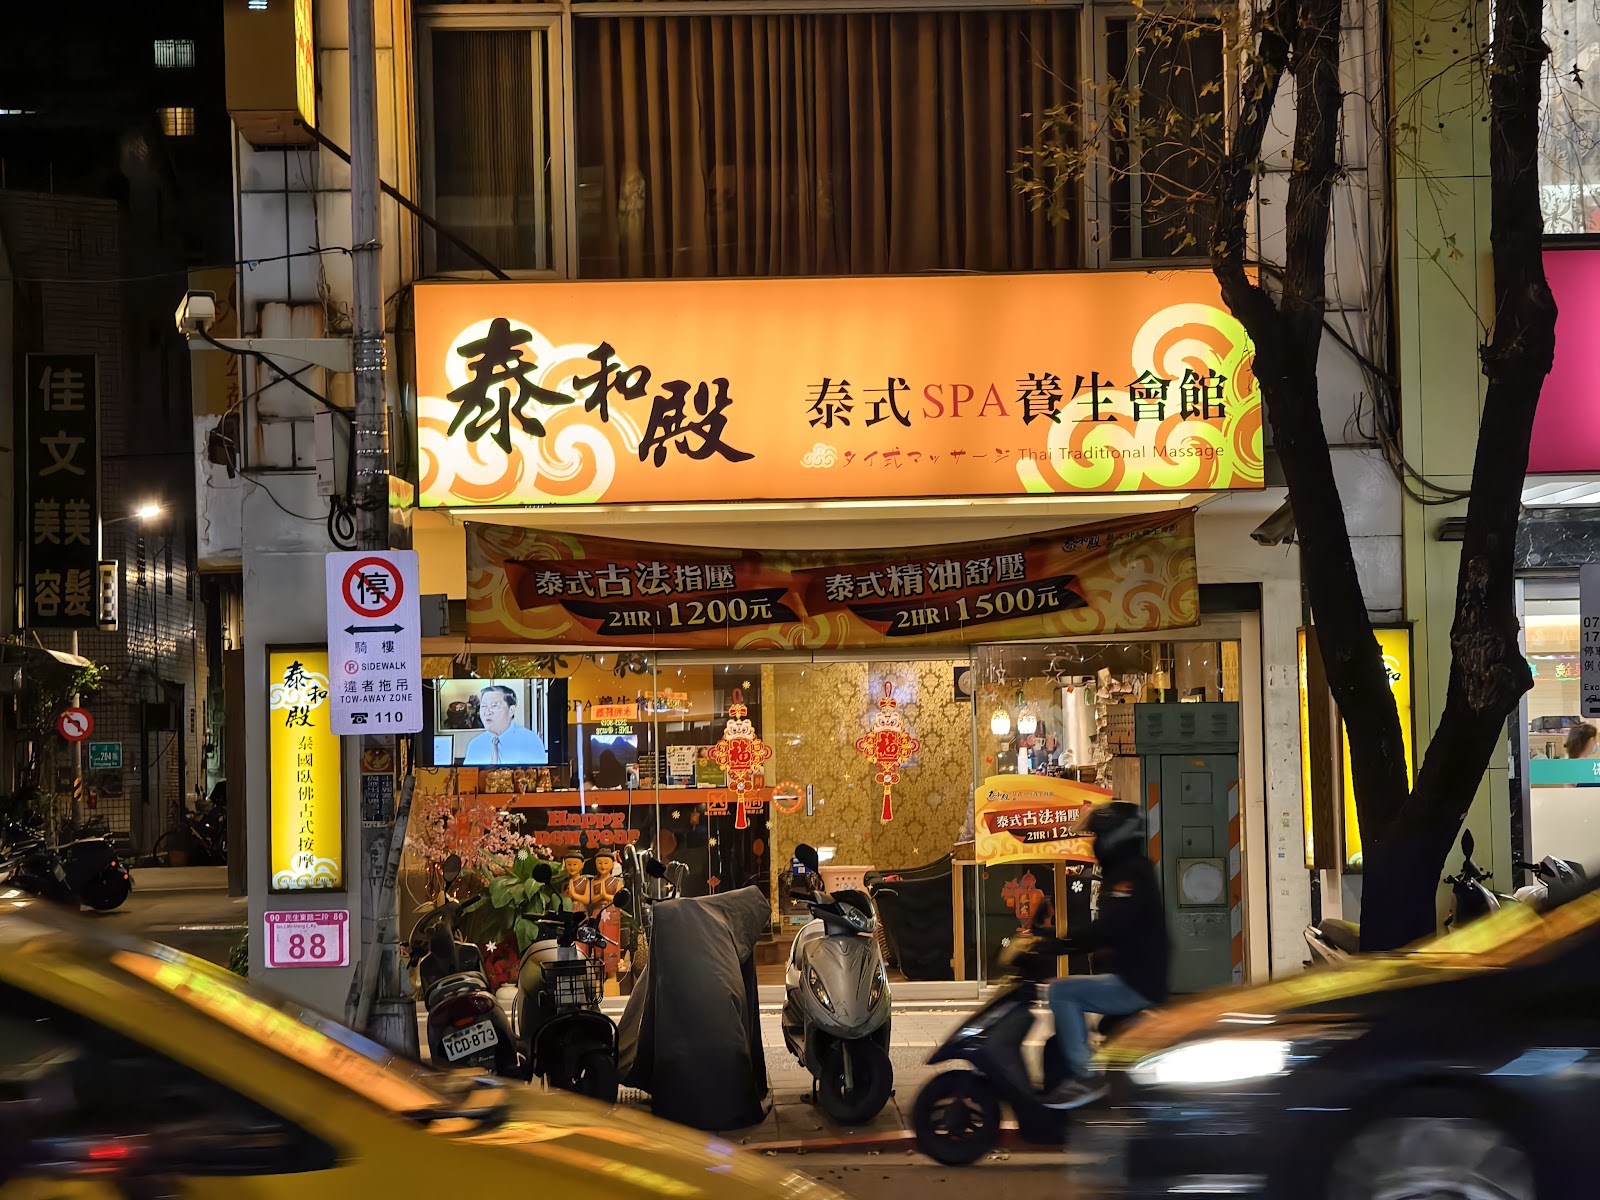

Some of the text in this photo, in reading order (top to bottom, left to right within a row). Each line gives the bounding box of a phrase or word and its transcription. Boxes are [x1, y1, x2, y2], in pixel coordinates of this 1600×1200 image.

[447, 317, 755, 467] 泰和殿
[39, 365, 85, 476] 佳文
[1018, 445, 1225, 463] Thai Traditional Massage
[357, 572, 389, 604] 停
[535, 562, 737, 598] 泰式古法指壓
[825, 552, 1026, 603] 泰式精油舒壓
[609, 598, 774, 628] 2HR 1200元
[897, 586, 1060, 629] 2HR 1500元
[361, 661, 406, 671] SIDEWALK
[284, 660, 329, 729] 泰和殿
[340, 693, 413, 704] TOW-AWAY ZONE
[344, 679, 409, 693] 違者拖吊
[375, 711, 403, 723] 110
[547, 810, 625, 829] Happy
[1027, 831, 1046, 841] 2HR
[289, 933, 327, 960] 88
[446, 1029, 495, 1056] YCD-873
